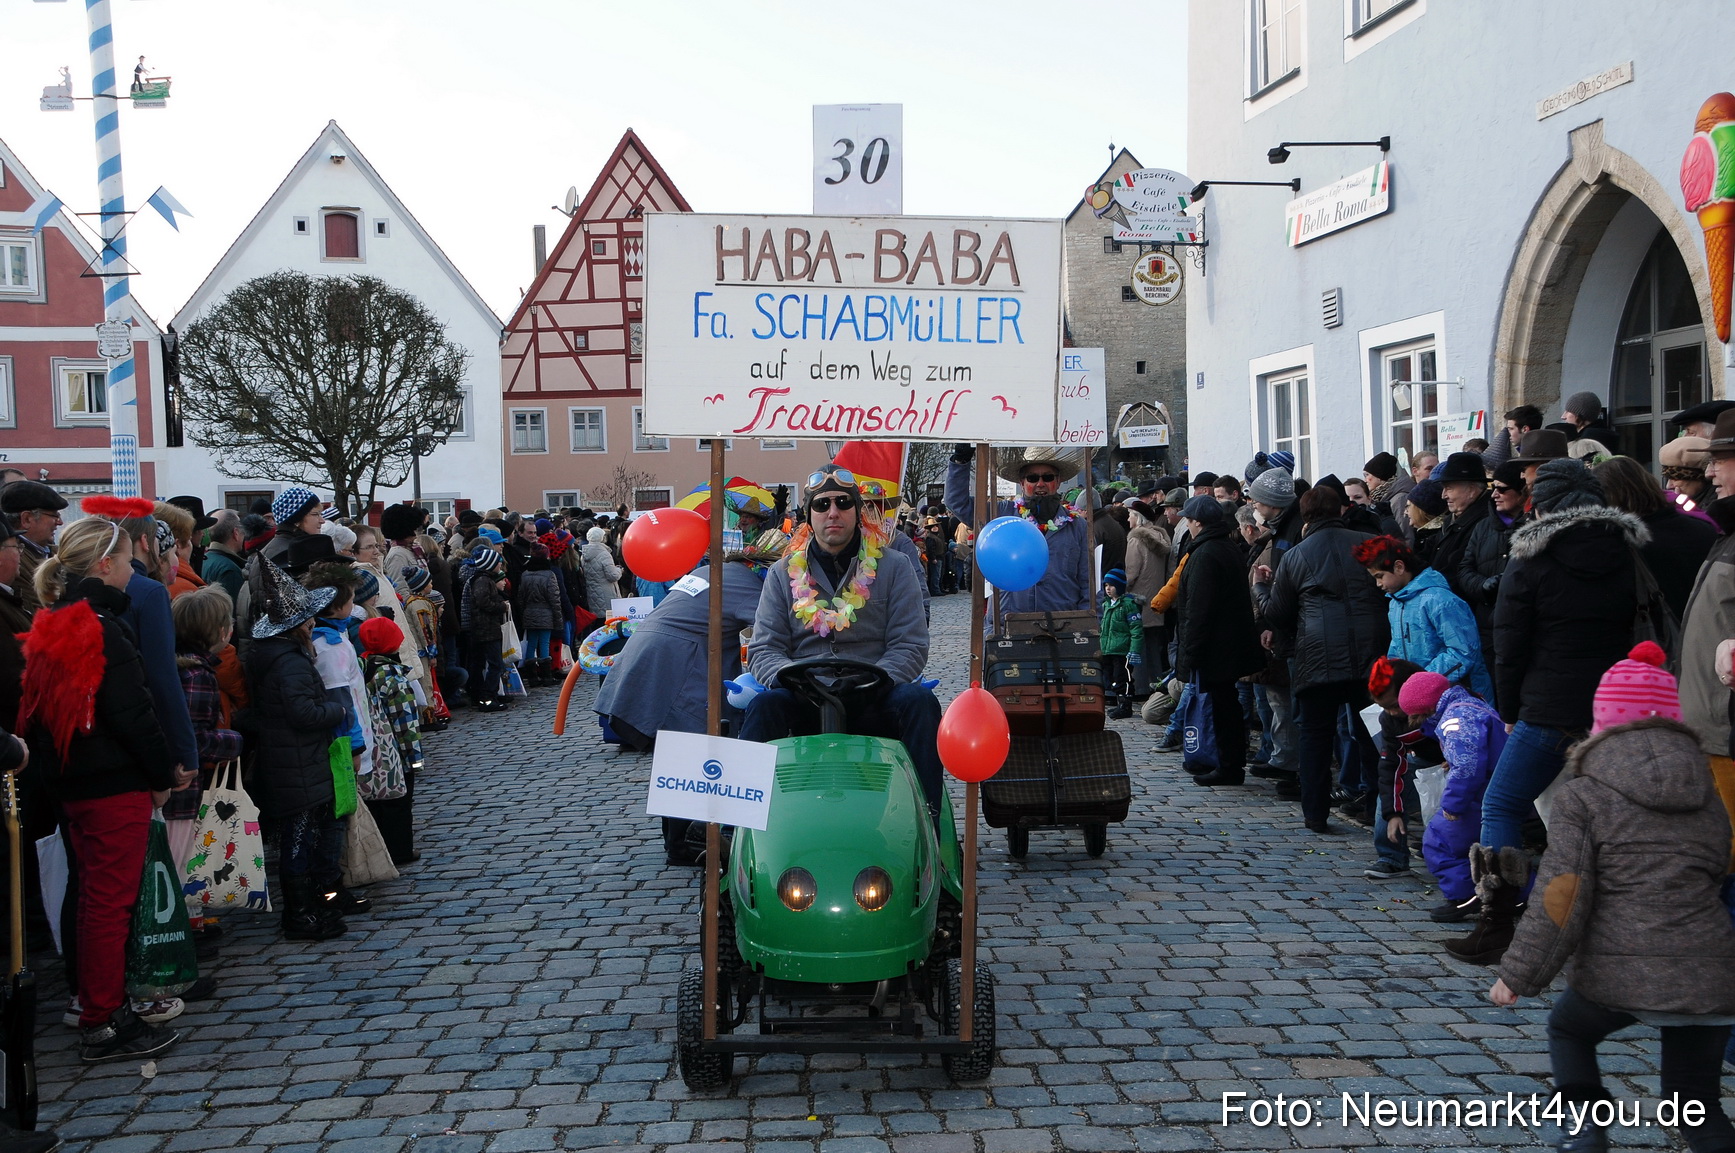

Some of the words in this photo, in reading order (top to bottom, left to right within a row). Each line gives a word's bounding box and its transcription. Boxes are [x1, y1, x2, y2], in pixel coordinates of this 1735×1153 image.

[823, 137, 890, 185] 30
[1132, 171, 1176, 183] Pizzeria
[1131, 200, 1178, 213] Eisdiele
[1143, 187, 1167, 198] Café
[1139, 224, 1171, 232] Bella
[1302, 207, 1330, 236] Bella
[1333, 199, 1368, 224] Roma
[715, 224, 1021, 287] HABA-BABA
[693, 291, 735, 340] Fa.
[750, 348, 789, 382] auf
[810, 350, 860, 381] dem
[870, 350, 913, 387] Weg
[925, 363, 973, 383] zum
